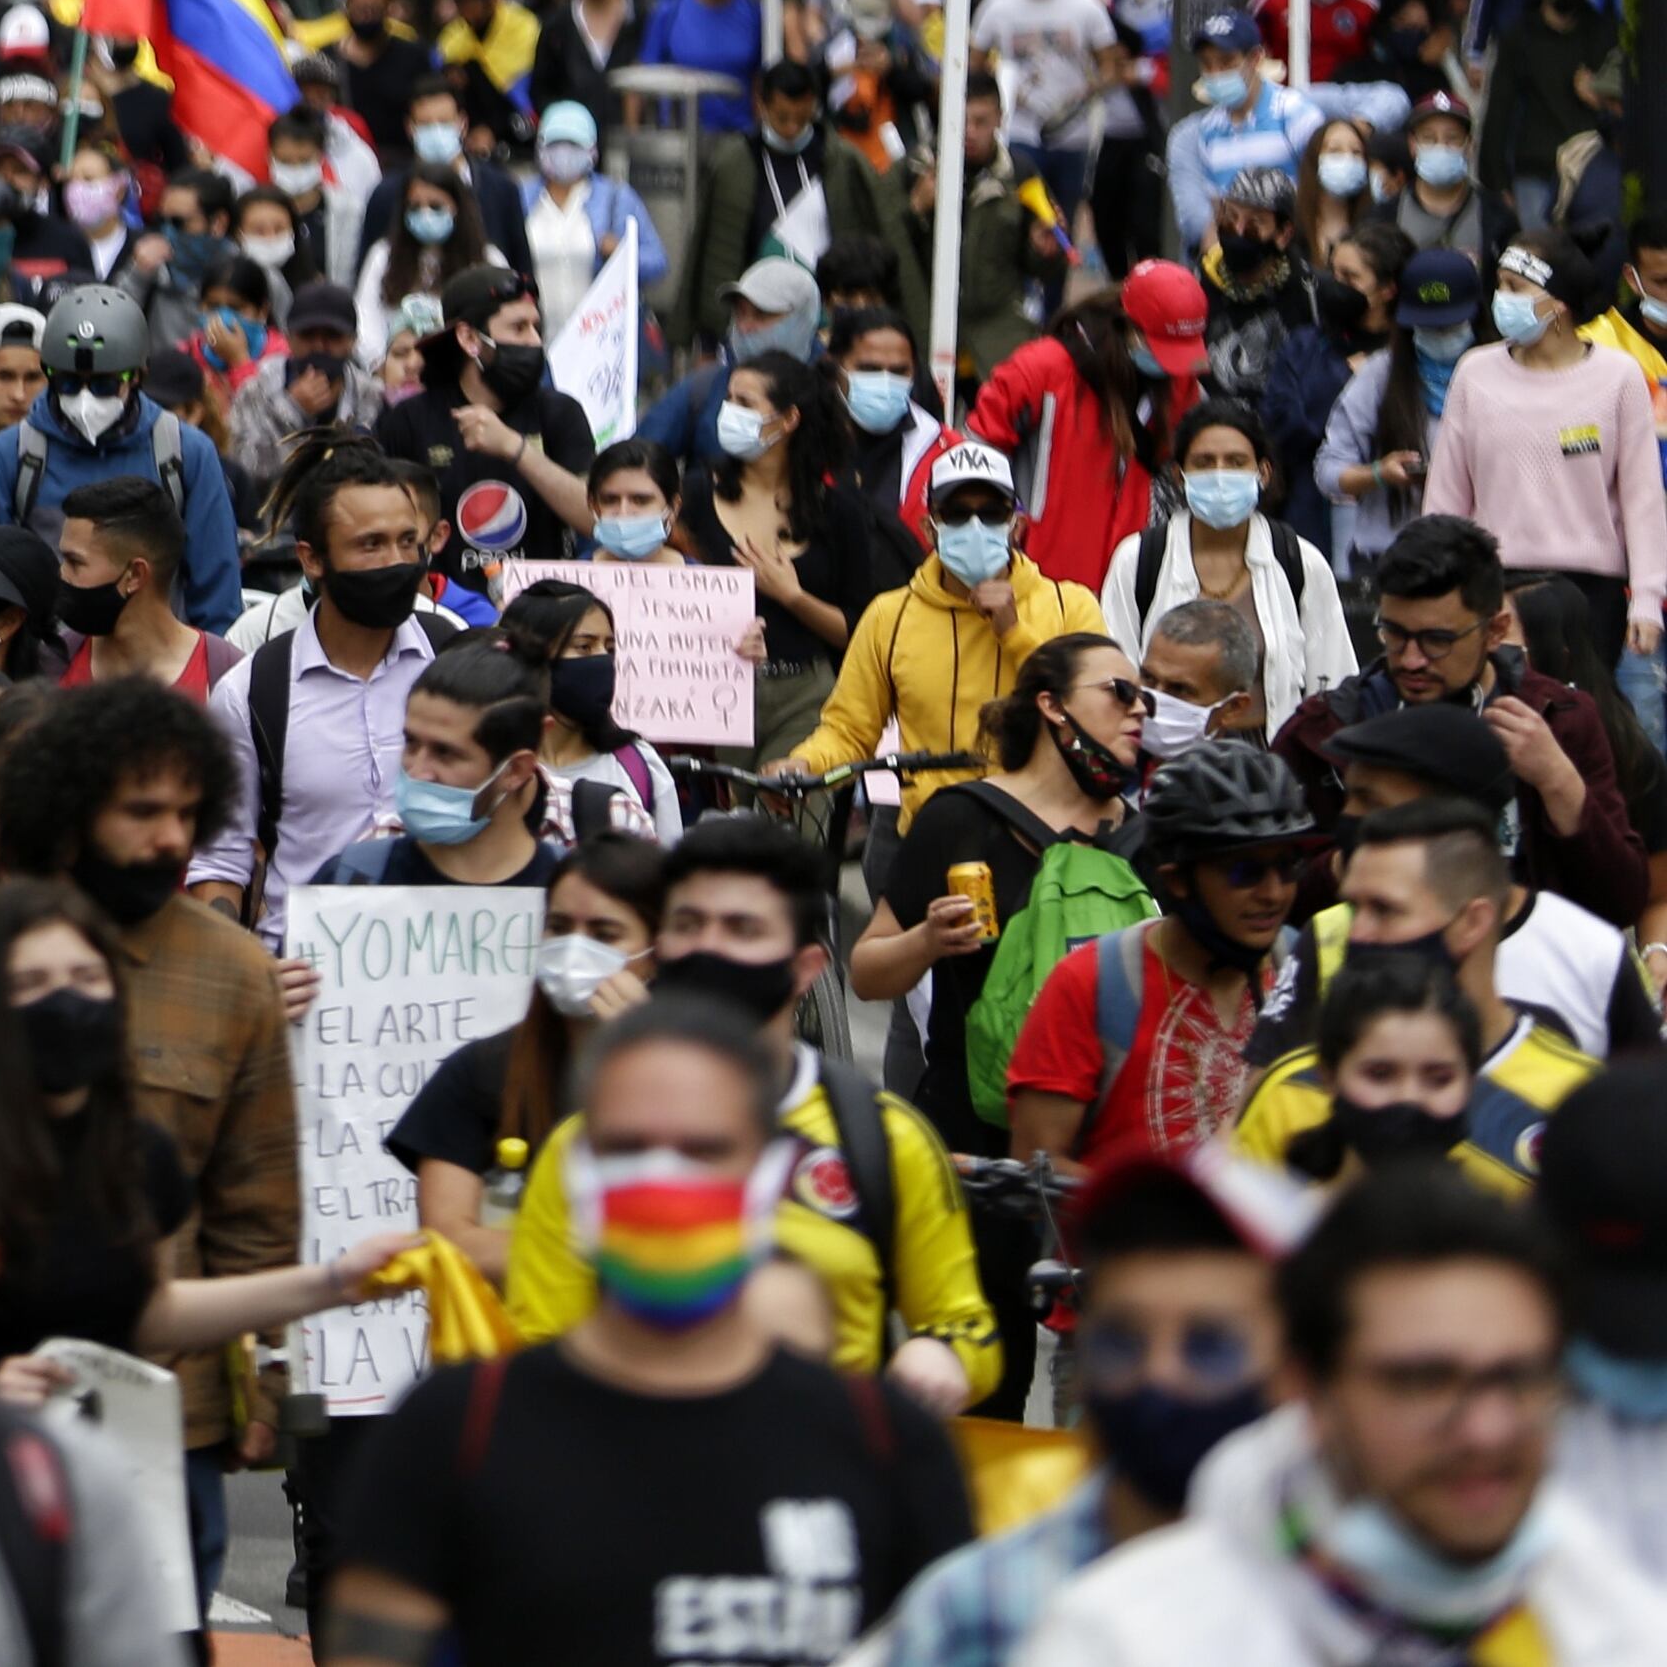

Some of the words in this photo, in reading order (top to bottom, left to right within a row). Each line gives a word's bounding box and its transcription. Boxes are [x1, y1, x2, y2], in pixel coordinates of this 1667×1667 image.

[612, 569, 652, 589] DEL
[668, 571, 740, 595] ESMAD
[641, 596, 714, 622] SEXUAL
[668, 631, 735, 658] MUJER
[648, 659, 746, 682] FEMINISTA
[317, 1005, 362, 1045] EL
[375, 997, 476, 1046] ARTE
[318, 1061, 365, 1099] LA
[318, 1119, 362, 1158] LA
[315, 1187, 364, 1221] EL
[320, 1327, 380, 1386] LA
